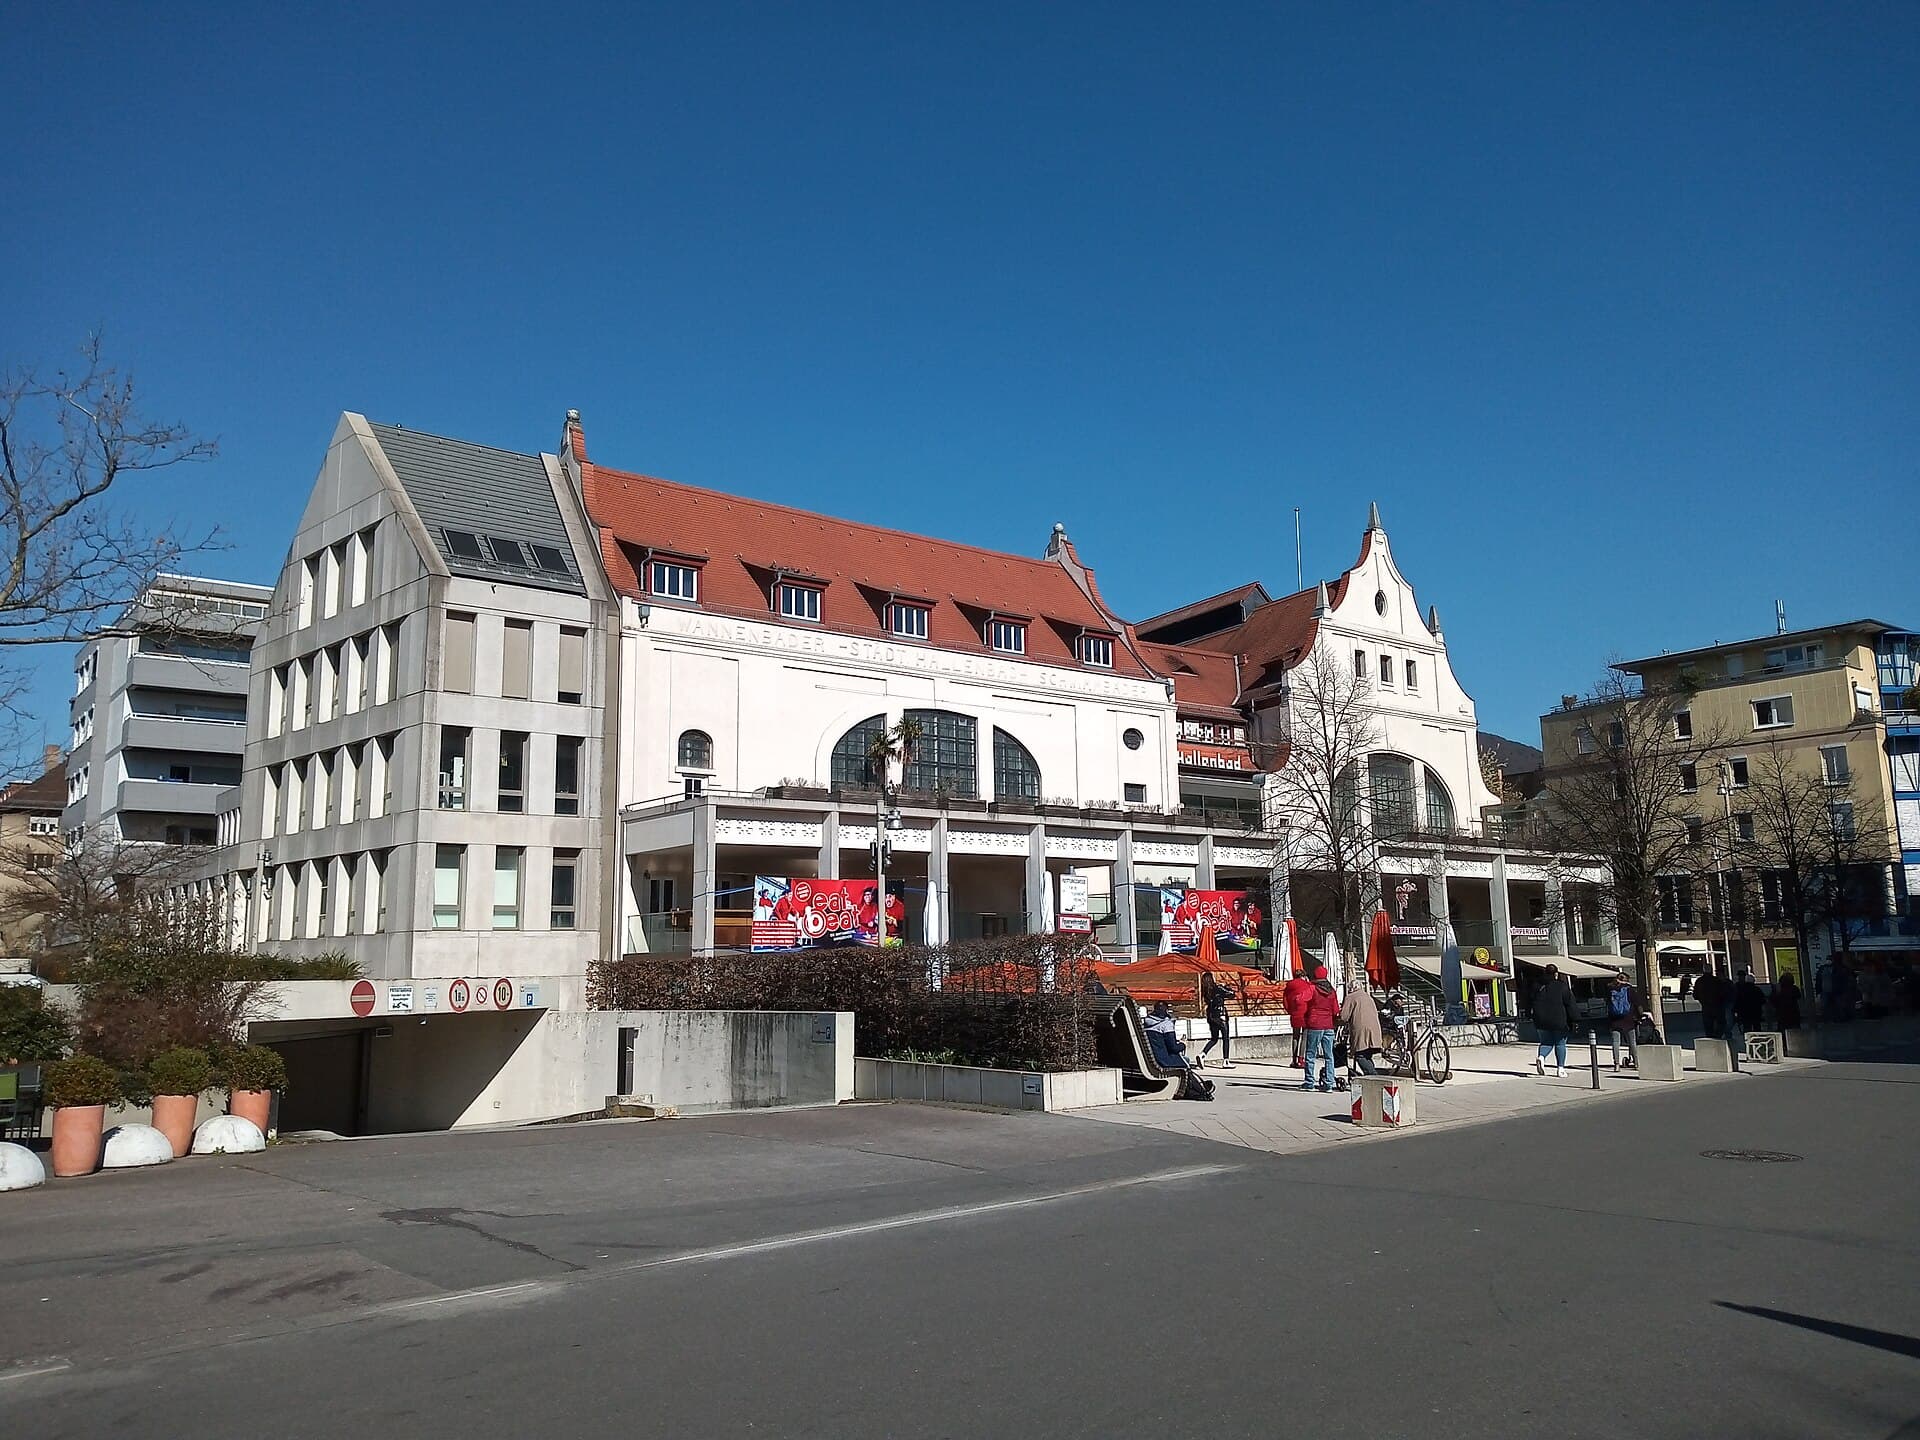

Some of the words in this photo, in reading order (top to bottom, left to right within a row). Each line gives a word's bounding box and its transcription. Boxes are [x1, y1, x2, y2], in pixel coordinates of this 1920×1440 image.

[1177, 750, 1241, 770] Hallenbad
[812, 886, 850, 912] eat
[1200, 895, 1226, 918] eat
[802, 904, 861, 938] beat
